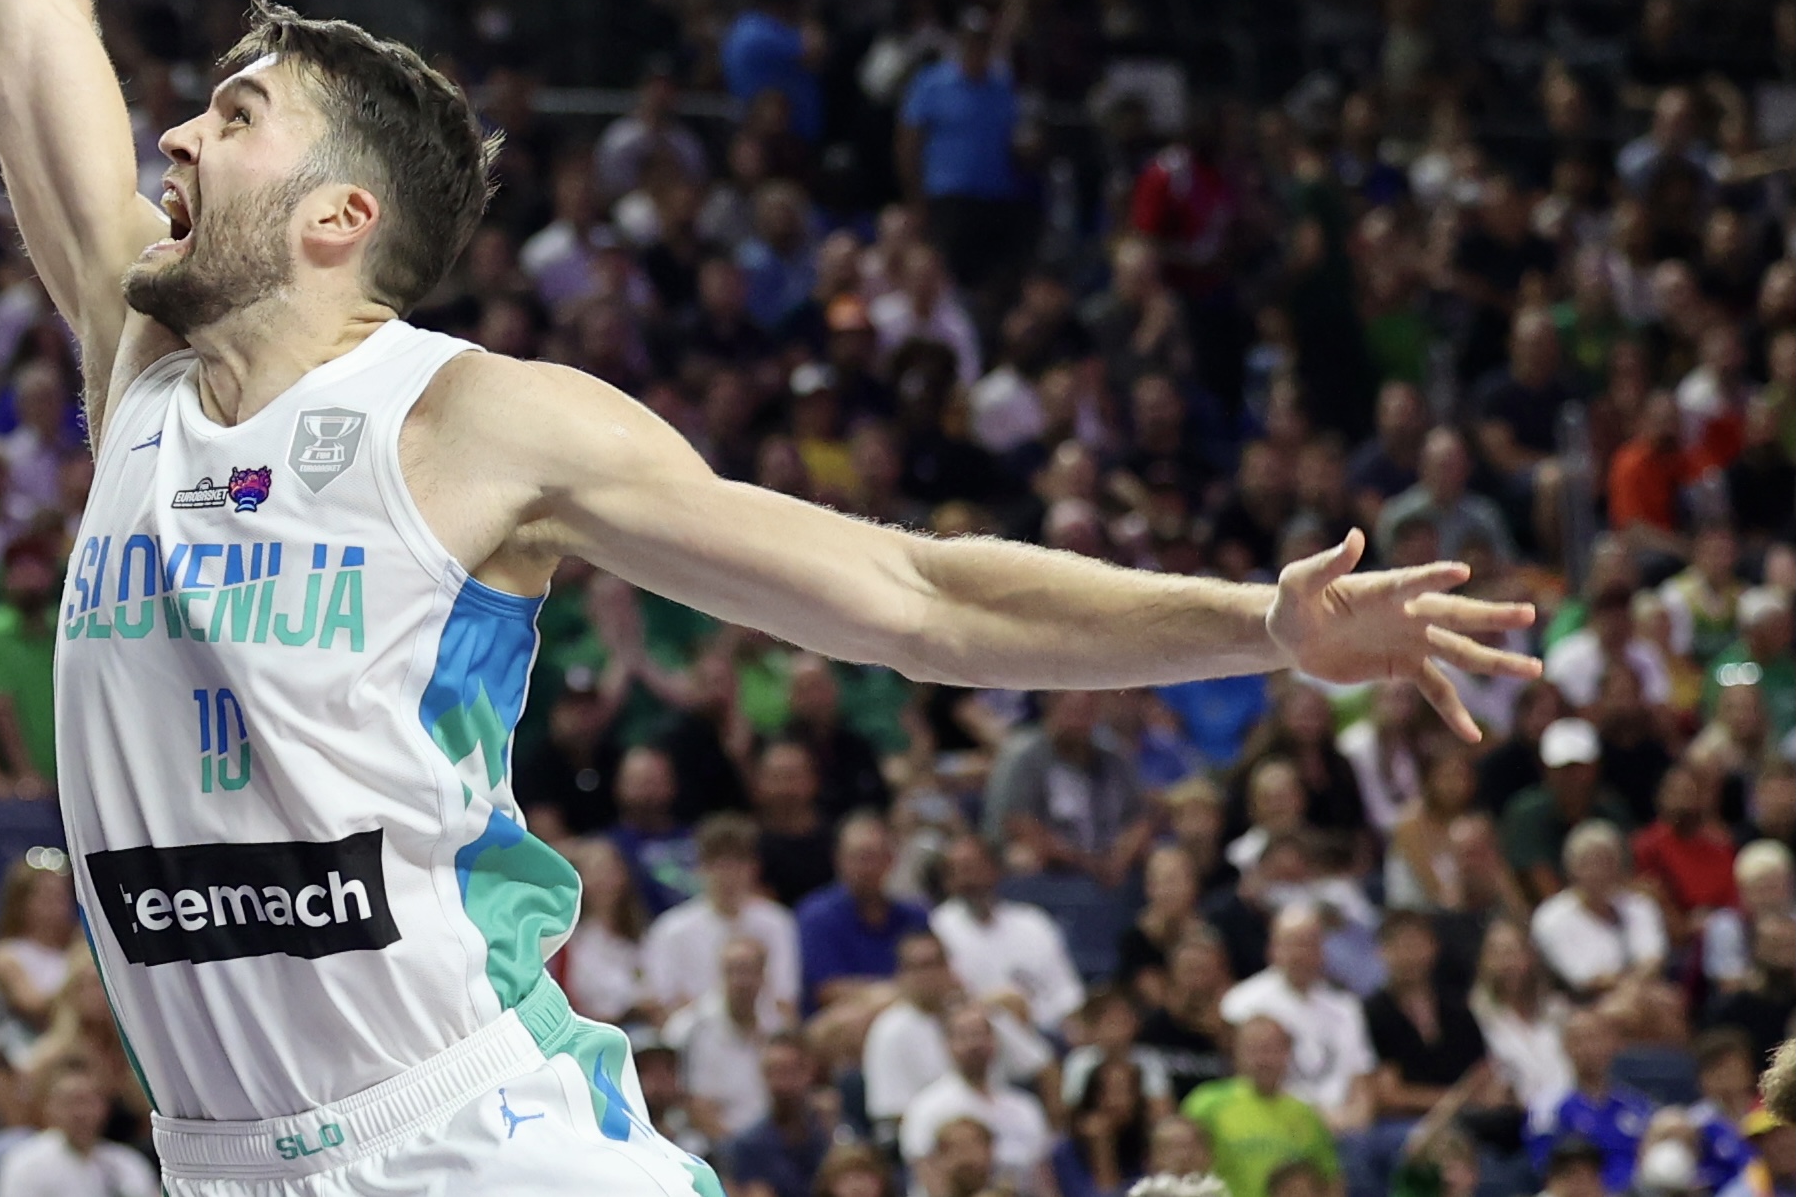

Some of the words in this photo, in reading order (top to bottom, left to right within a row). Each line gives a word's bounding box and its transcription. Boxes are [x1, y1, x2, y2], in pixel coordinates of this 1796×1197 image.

[175, 489, 228, 502] EUROBASKET
[65, 534, 366, 653] SLOVENIJA
[193, 688, 252, 793] 10
[275, 1123, 345, 1161] SLO
